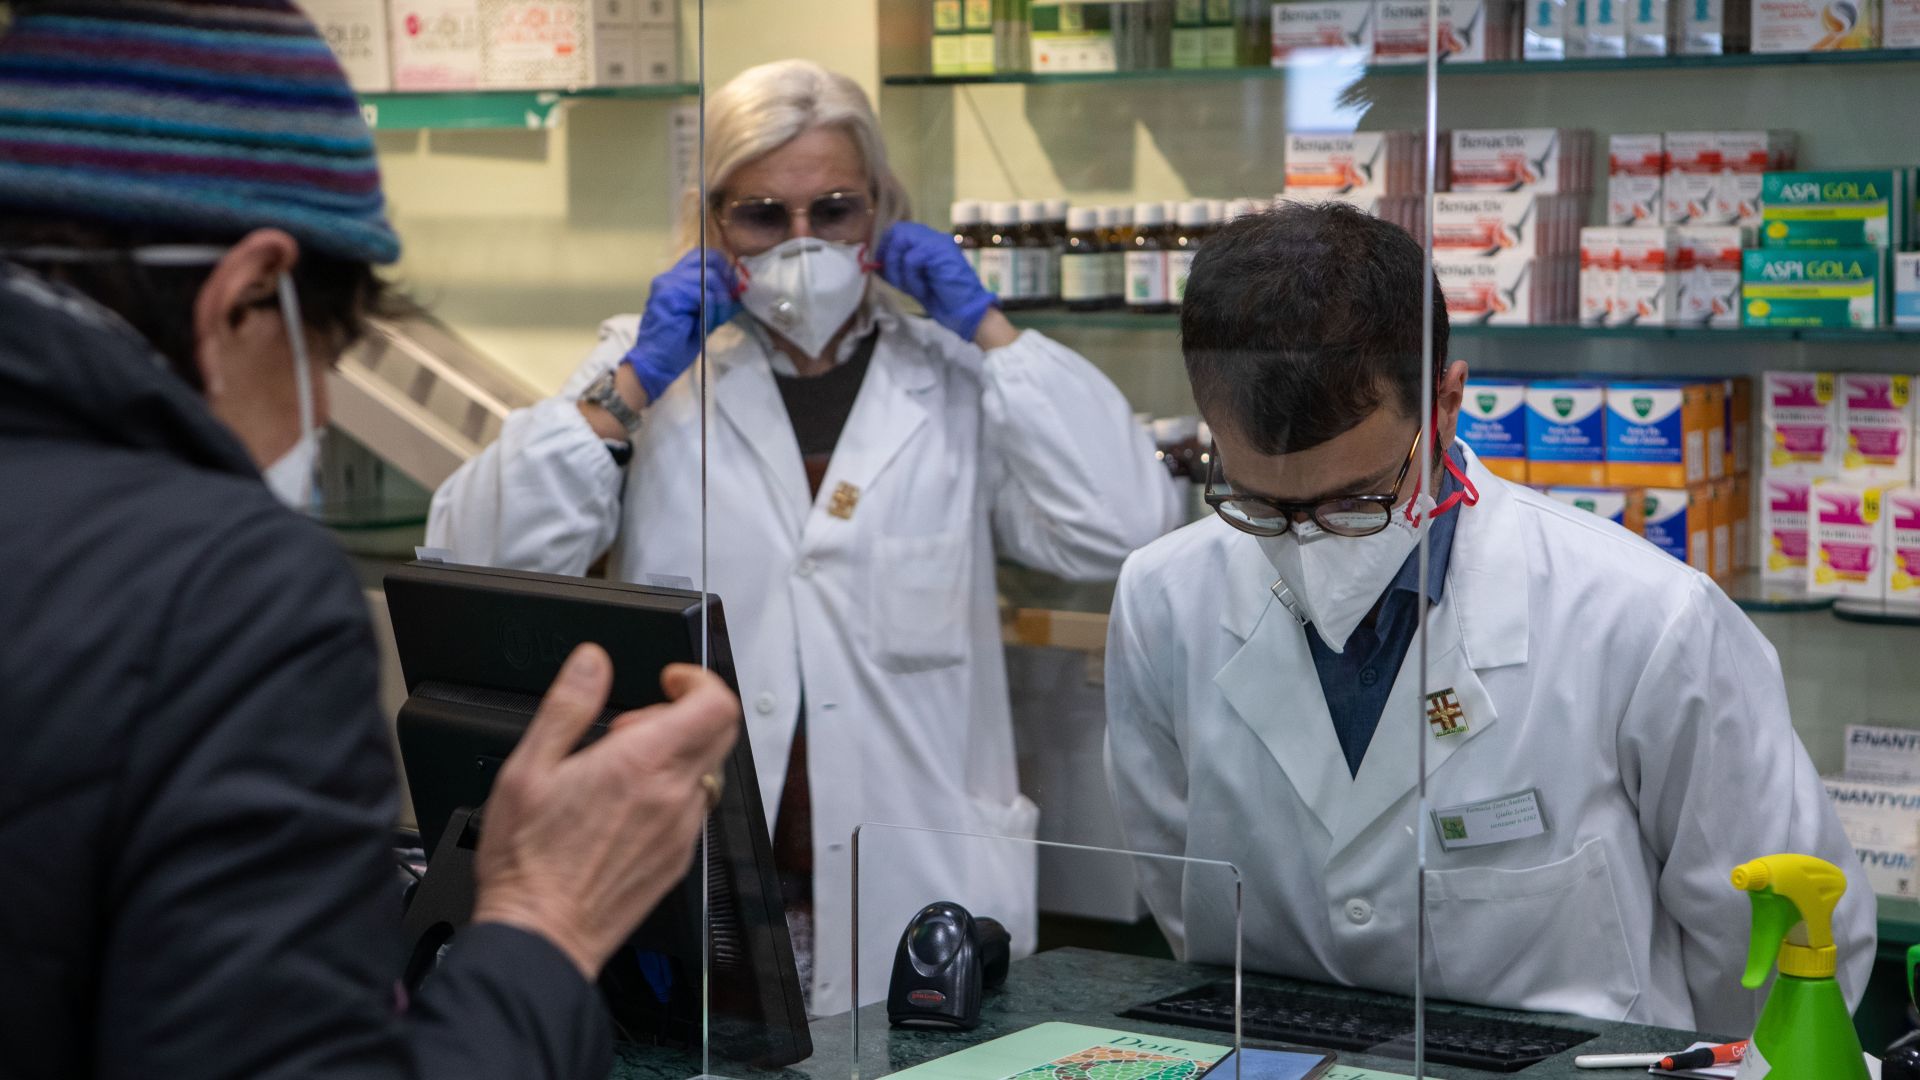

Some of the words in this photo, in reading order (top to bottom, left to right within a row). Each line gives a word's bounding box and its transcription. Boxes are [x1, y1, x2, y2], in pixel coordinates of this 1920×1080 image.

[1780, 182, 1821, 200] ASPI
[1823, 182, 1878, 200] GOLA
[1761, 260, 1804, 279] ASPI
[1806, 260, 1864, 279] GOLA
[1851, 729, 1920, 751] ENANT
[1107, 1036, 1191, 1056] Dott.
